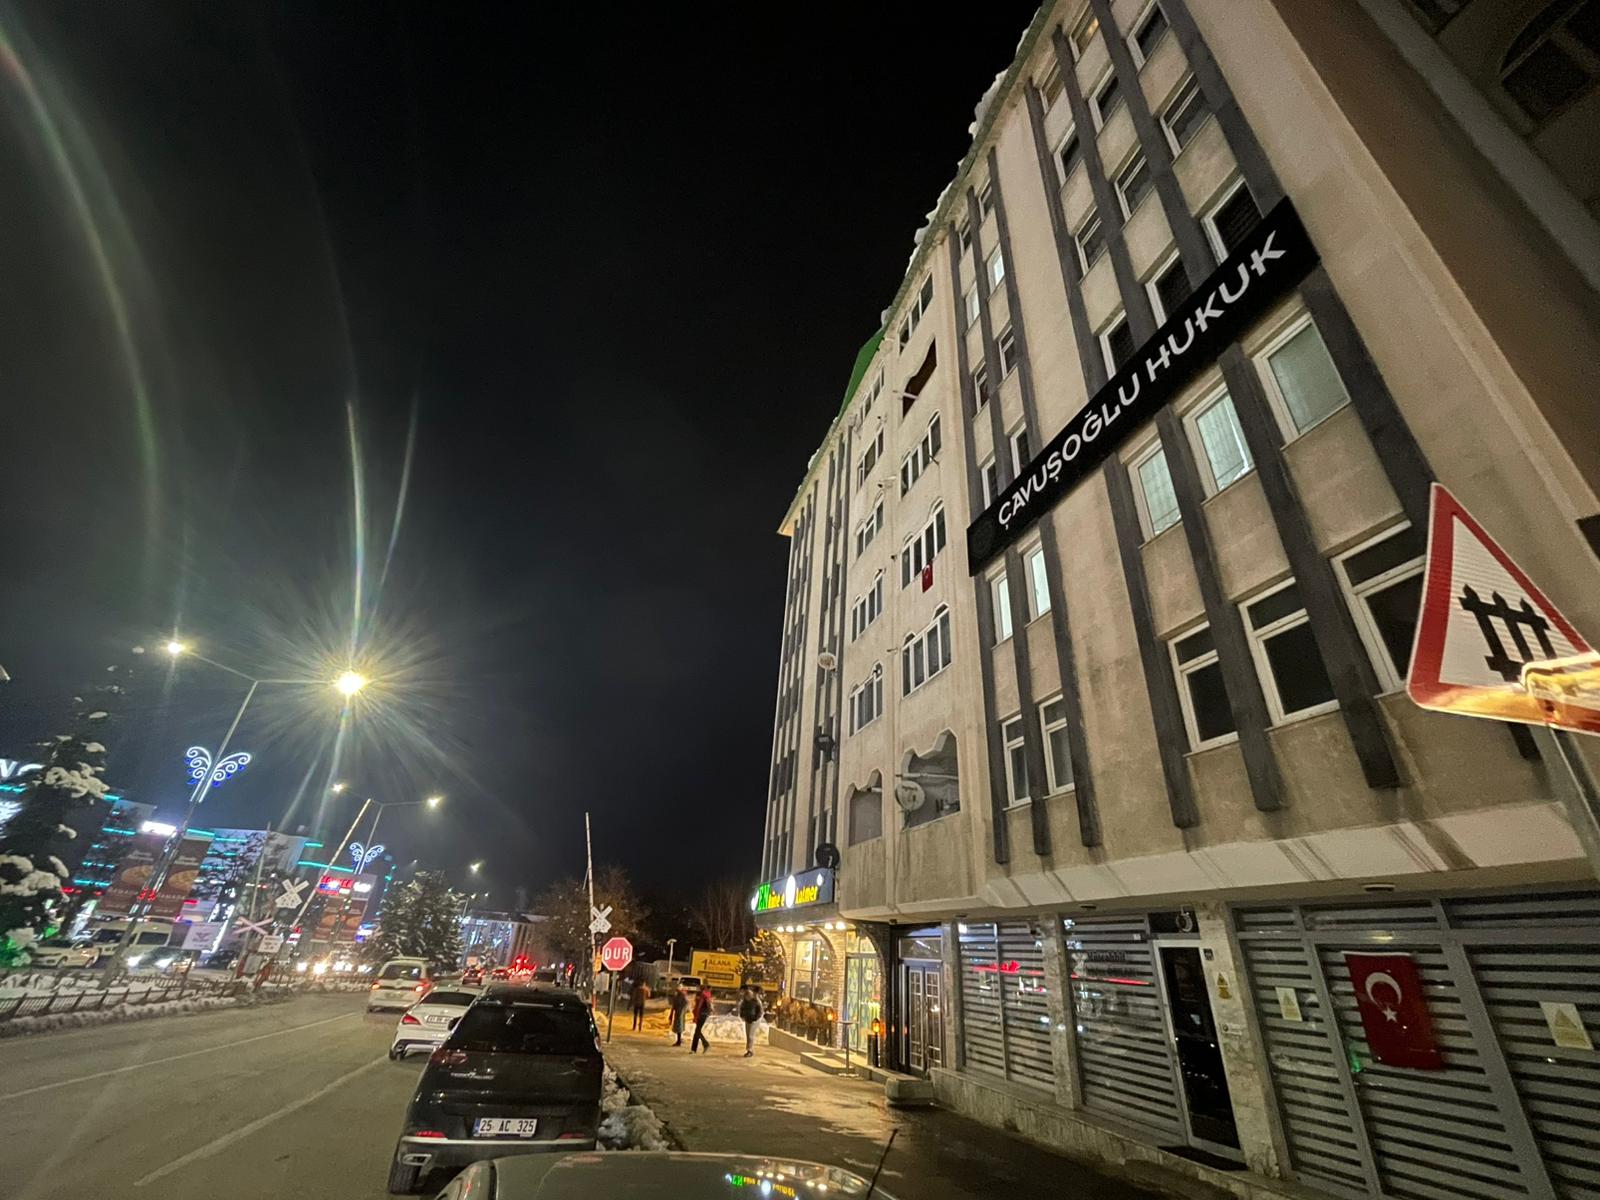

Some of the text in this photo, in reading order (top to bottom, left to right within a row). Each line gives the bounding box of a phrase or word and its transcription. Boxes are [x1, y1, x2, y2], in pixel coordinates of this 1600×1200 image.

[998, 229, 1287, 532] ÇAVUŞOĞLU HUKUK
[604, 947, 630, 961] DUR
[480, 1120, 535, 1133] 25 AC 325
